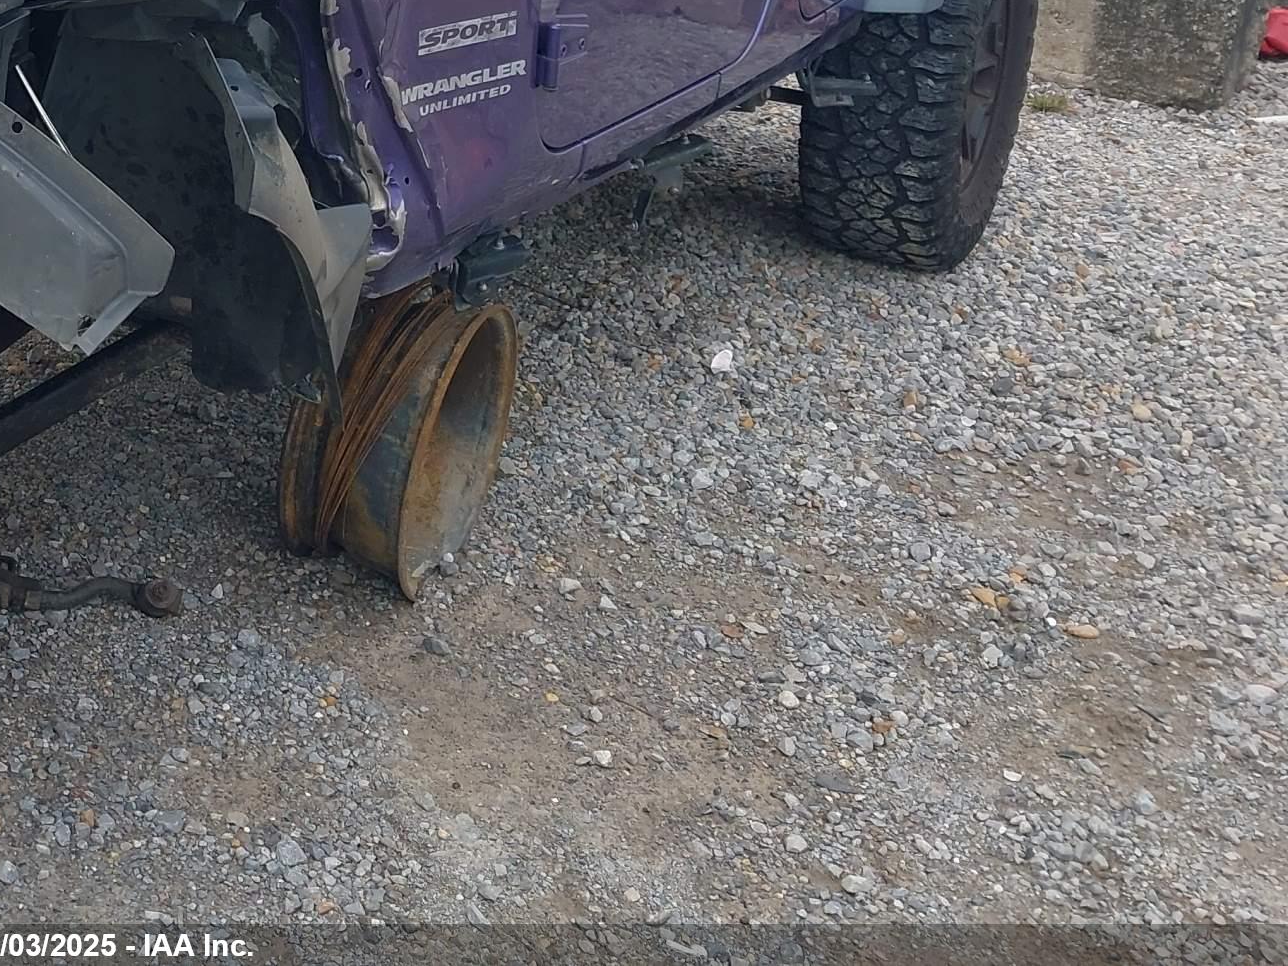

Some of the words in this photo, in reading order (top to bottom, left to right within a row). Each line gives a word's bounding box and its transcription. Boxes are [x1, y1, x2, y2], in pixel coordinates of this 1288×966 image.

[418, 17, 517, 50] SPORT
[401, 59, 526, 106] WRANGLER
[419, 84, 511, 116] UNLIMITED
